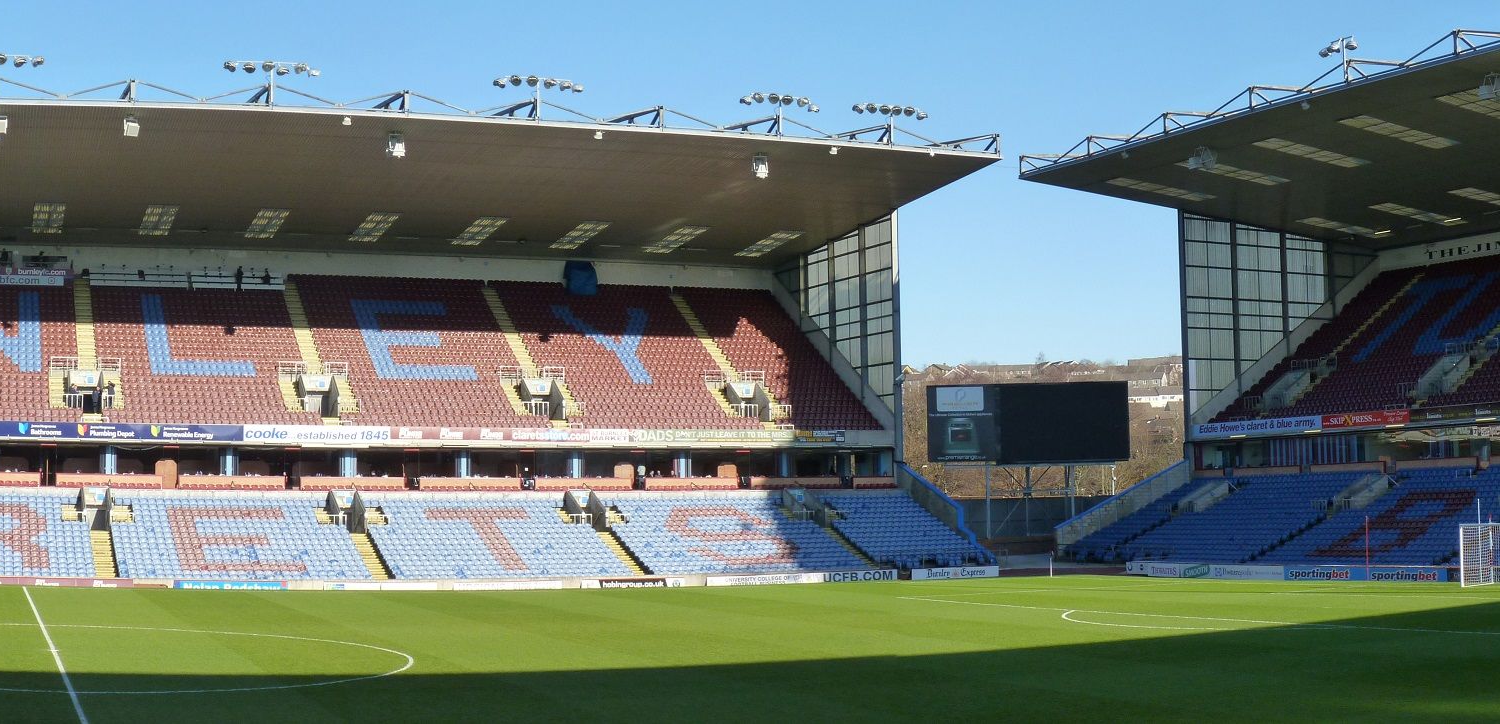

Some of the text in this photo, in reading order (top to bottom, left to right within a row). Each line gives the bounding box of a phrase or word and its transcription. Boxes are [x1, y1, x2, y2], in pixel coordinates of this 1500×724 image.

[1424, 246, 1469, 259] THE
[18, 268, 66, 276] burnleyfc.com
[1199, 419, 1316, 434] Eddie Howe's claret & blue army.
[30, 428, 62, 436] Bathrooms
[89, 430, 135, 438] Plumbing Depot
[194, 432, 214, 440] Energy
[245, 428, 288, 439] cooke
[360, 430, 389, 440] 1845
[512, 430, 590, 441] claretsstore.com
[639, 430, 674, 442] DADS
[697, 431, 714, 439] JUST
[714, 431, 738, 439] LEAVE
[738, 431, 746, 439] IT
[746, 431, 758, 439] TO
[758, 431, 772, 439] THE
[823, 571, 893, 583] UCFB.COM
[961, 567, 986, 577] Express
[1289, 569, 1350, 579] sportingbet
[1371, 571, 1438, 582] sportingbet
[603, 580, 666, 589] hobingroup.co.uk
